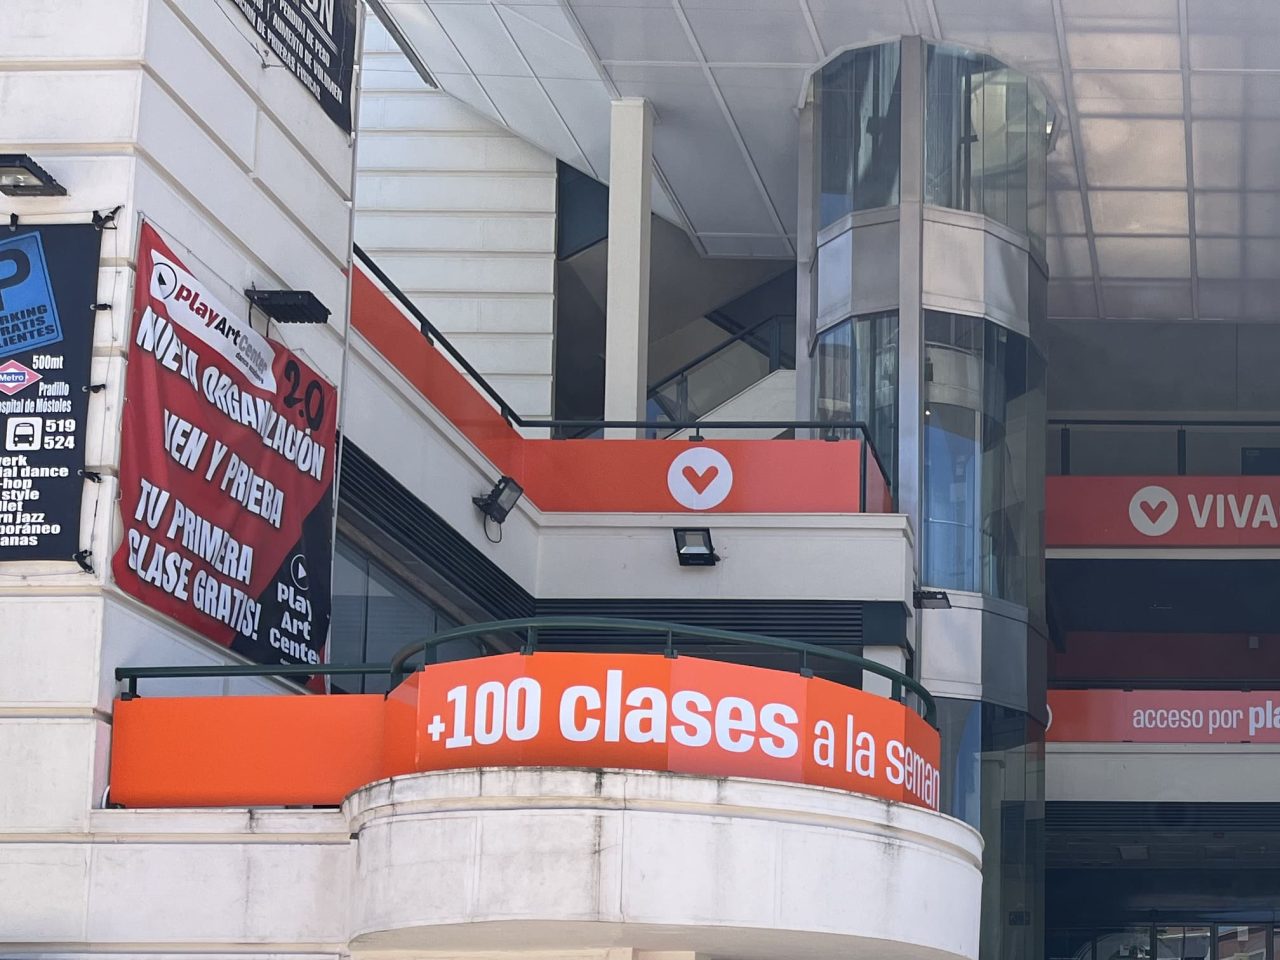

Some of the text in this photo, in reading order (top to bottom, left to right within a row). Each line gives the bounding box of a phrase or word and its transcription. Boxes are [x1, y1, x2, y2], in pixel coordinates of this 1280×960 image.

[32, 355, 64, 370] 500mt
[38, 382, 70, 396] Pradillo
[284, 359, 325, 431] 2.0
[25, 399, 35, 413] de
[36, 398, 72, 413] Móstoles
[45, 419, 76, 432] 519
[43, 436, 75, 449] 524
[205, 440, 228, 481] Y
[20, 466, 69, 477] dance
[2, 489, 40, 501] style
[134, 477, 170, 530] TU
[15, 512, 45, 523] jazz
[128, 528, 262, 640] CLASE GRATIS!
[281, 611, 311, 640] Art
[427, 677, 542, 749] +100
[559, 669, 799, 759] clases
[813, 719, 835, 768] a
[846, 714, 876, 779] la
[1132, 706, 1203, 729] acceso
[1208, 707, 1243, 735] por
